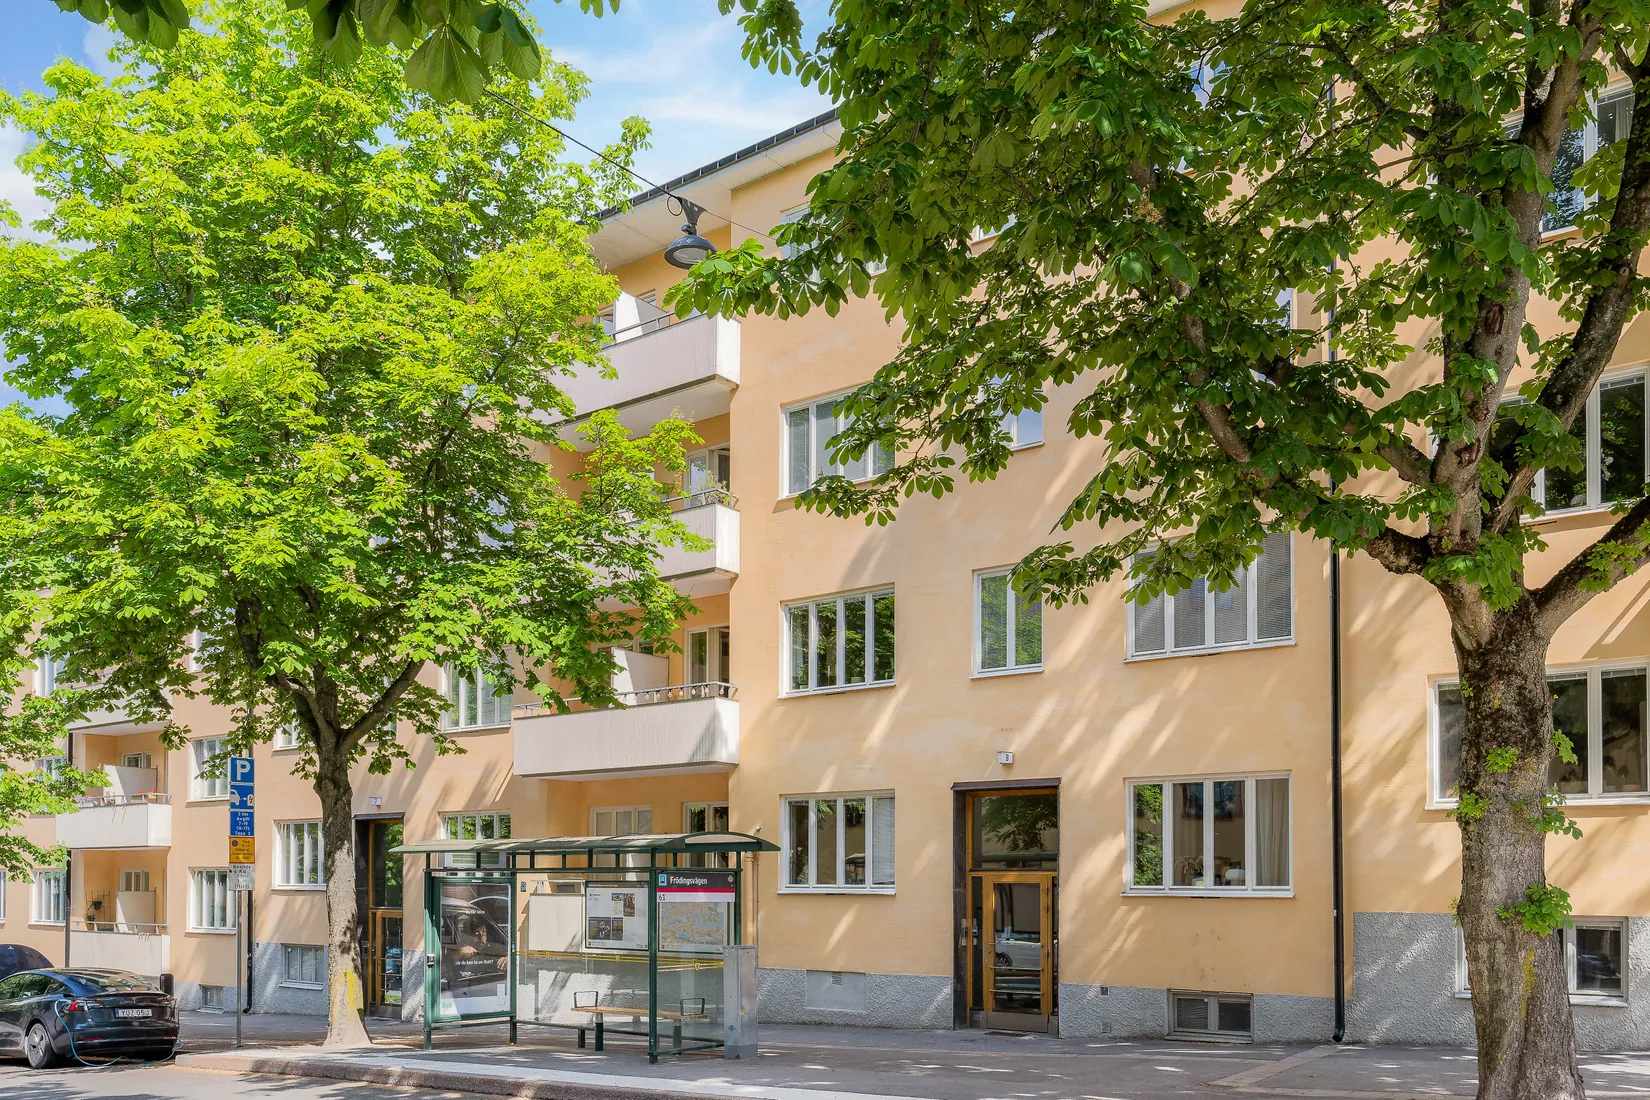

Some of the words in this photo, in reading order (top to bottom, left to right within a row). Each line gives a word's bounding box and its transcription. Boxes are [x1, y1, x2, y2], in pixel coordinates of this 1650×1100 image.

[1005, 753, 1010, 762] 9
[236, 759, 251, 781] P
[669, 876, 708, 886] Frödingsvägen
[658, 893, 666, 901] 61
